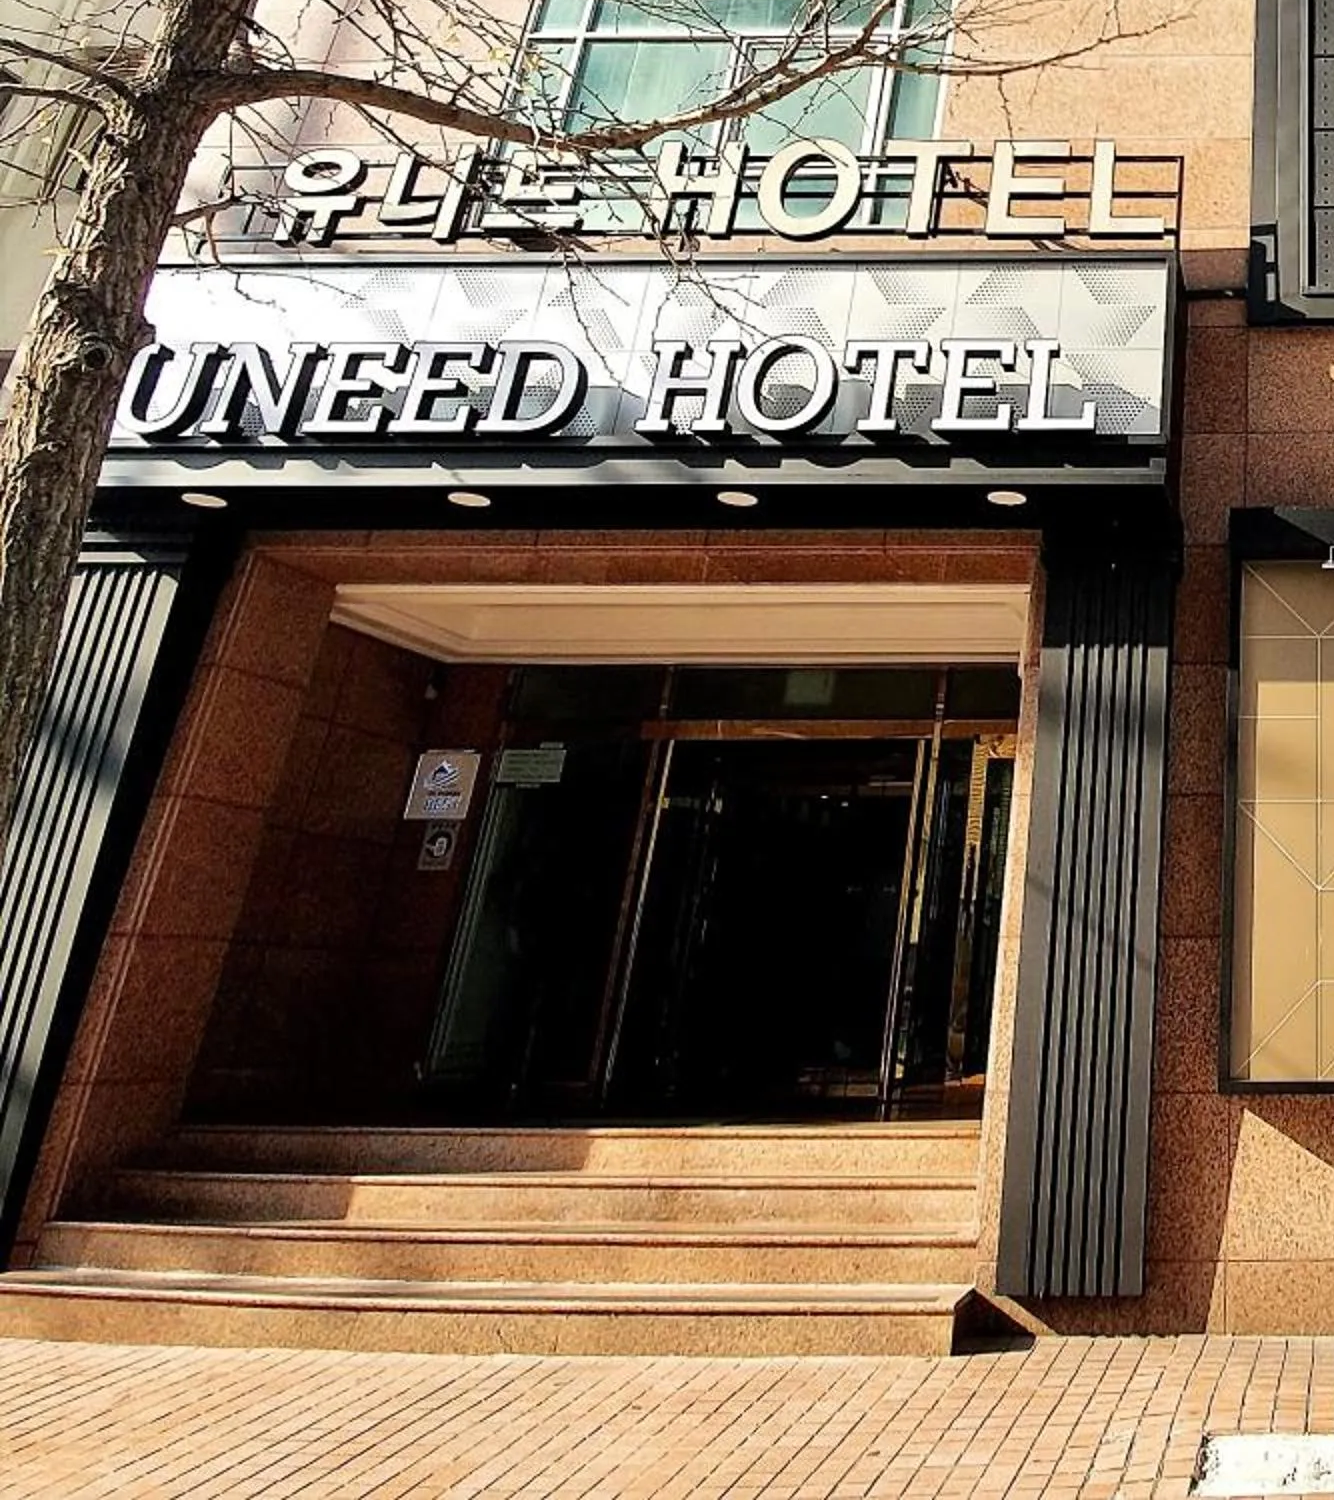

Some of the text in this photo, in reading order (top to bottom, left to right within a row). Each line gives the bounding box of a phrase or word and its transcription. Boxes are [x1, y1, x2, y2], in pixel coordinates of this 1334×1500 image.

[648, 139, 1172, 240] HOTEL
[113, 338, 1098, 440] UNEED HOTEL
